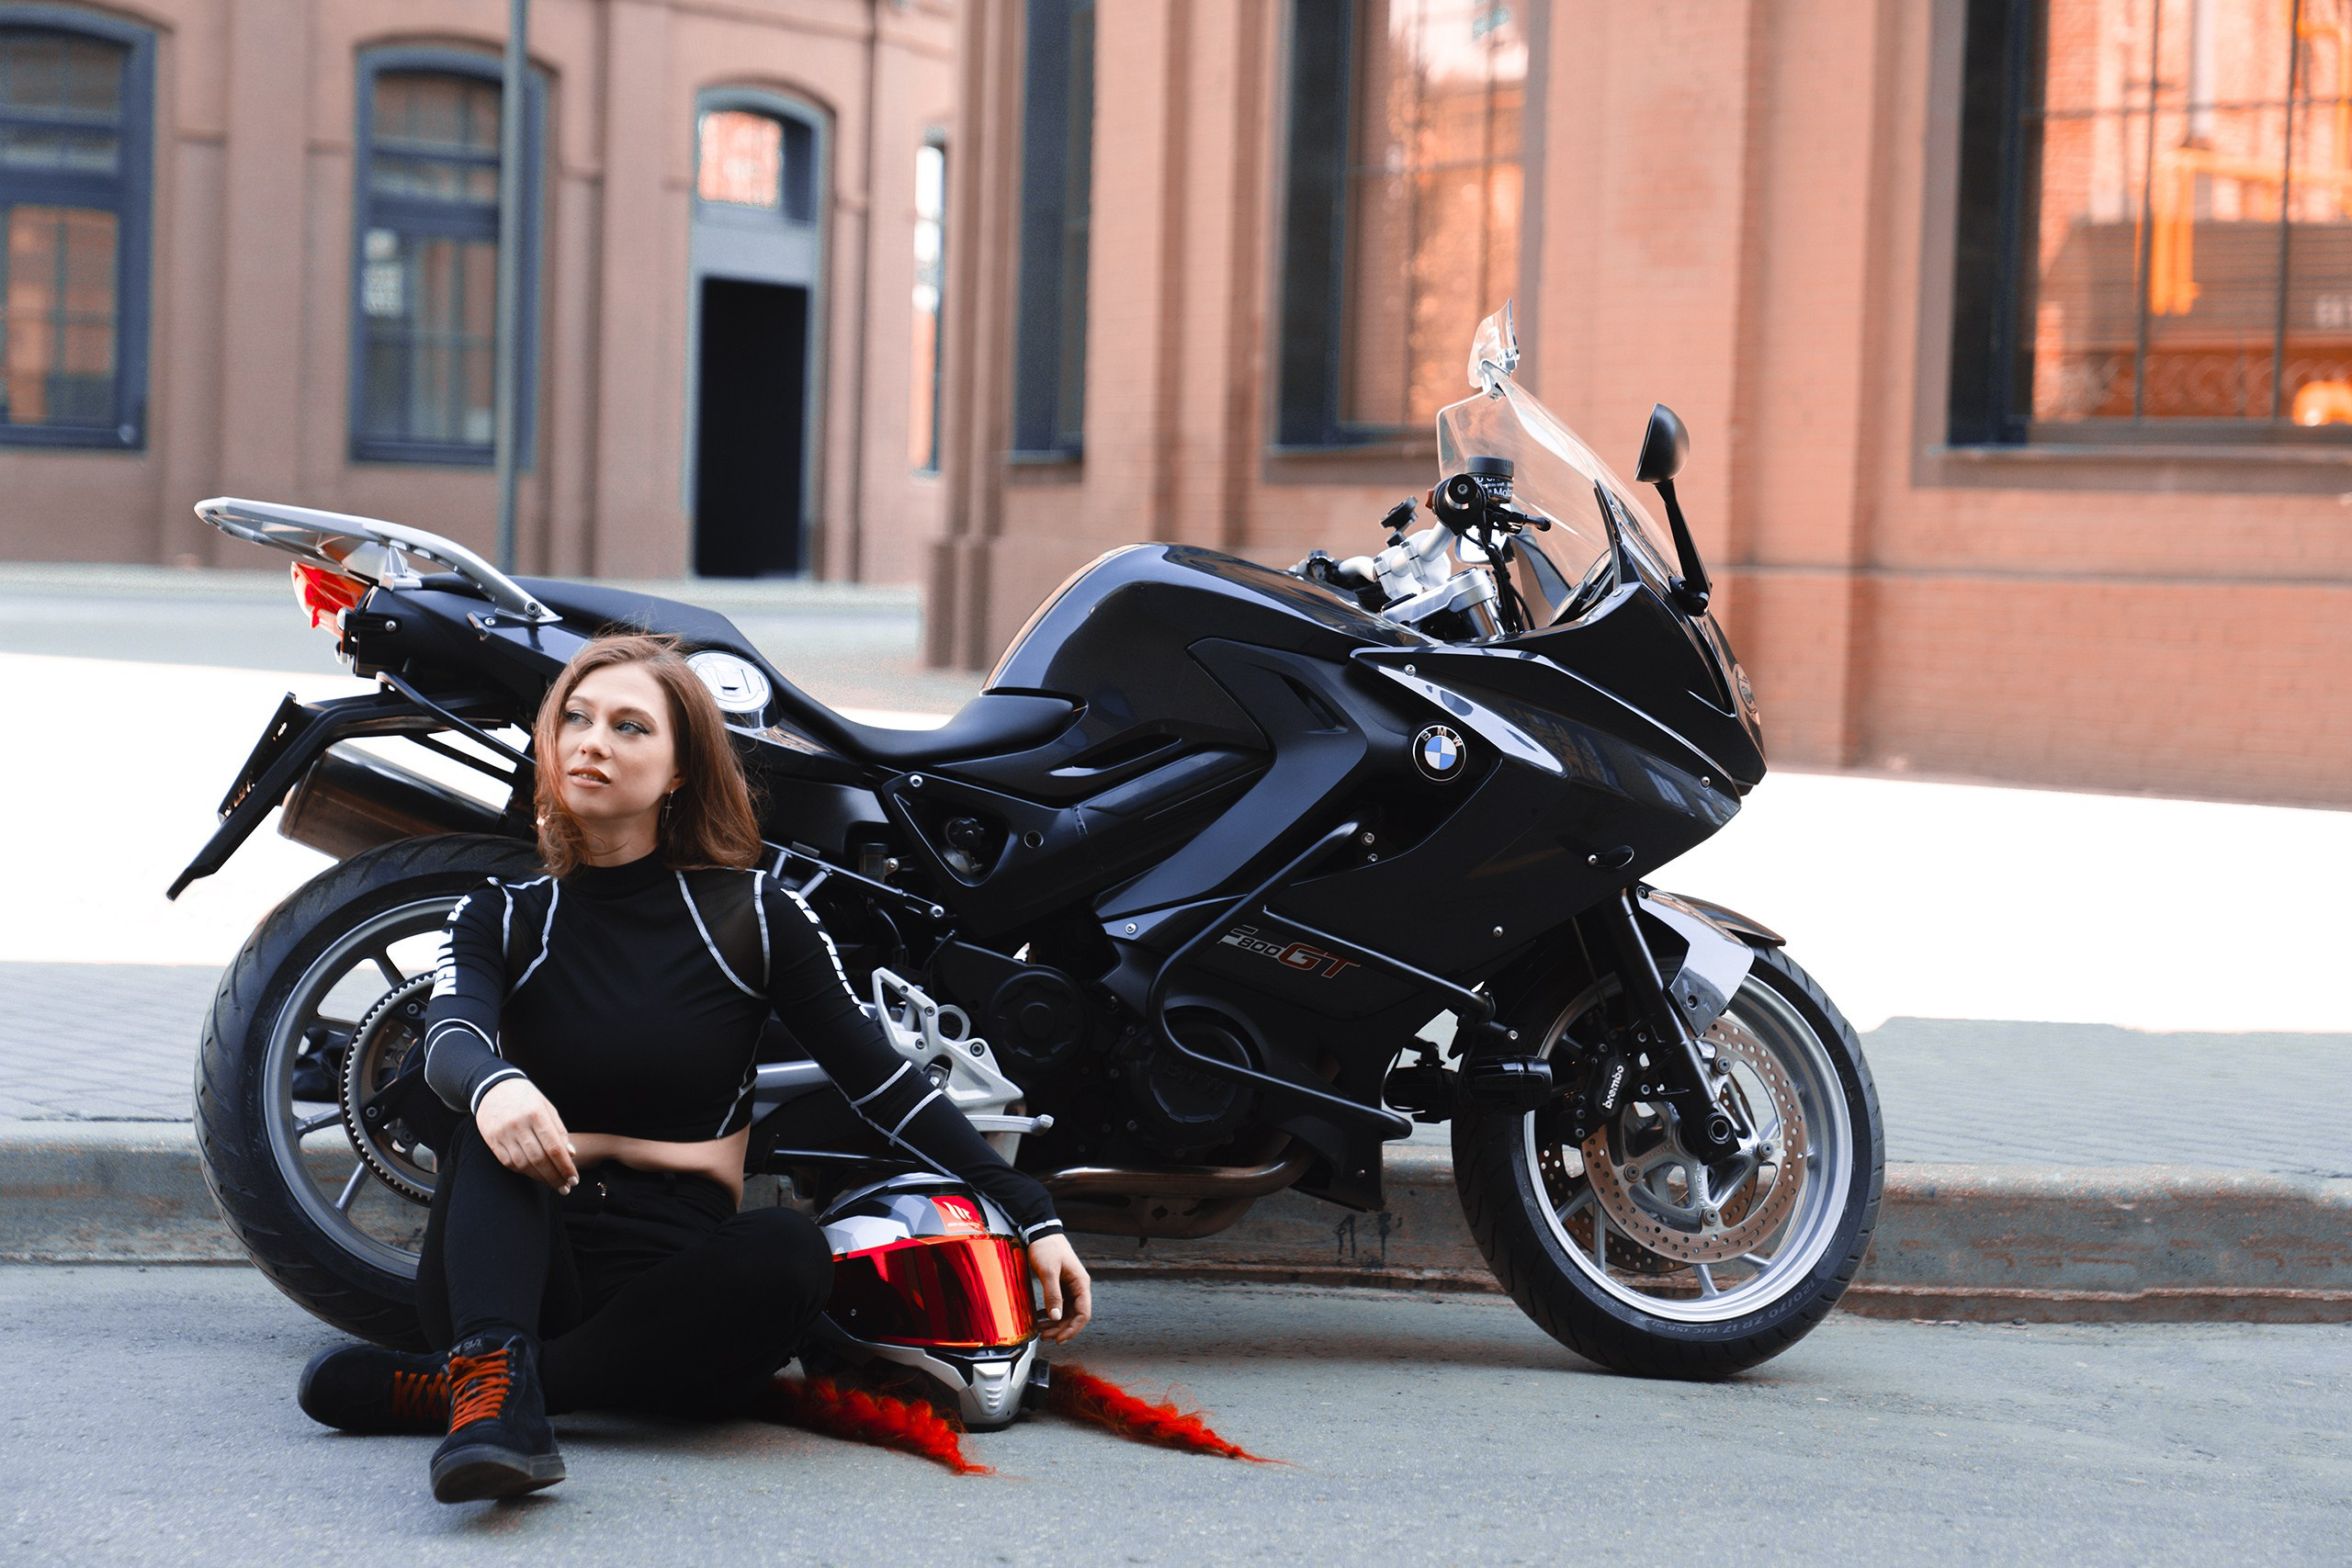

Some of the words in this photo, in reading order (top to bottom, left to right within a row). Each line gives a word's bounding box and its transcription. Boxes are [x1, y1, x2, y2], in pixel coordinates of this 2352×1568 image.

[1420, 727, 1463, 748] BMW
[1602, 1065, 1624, 1110] brembo
[1768, 1279, 1815, 1319] 120/70
[1722, 1323, 1738, 1335] 17
[1742, 1314, 1765, 1329] ZR
